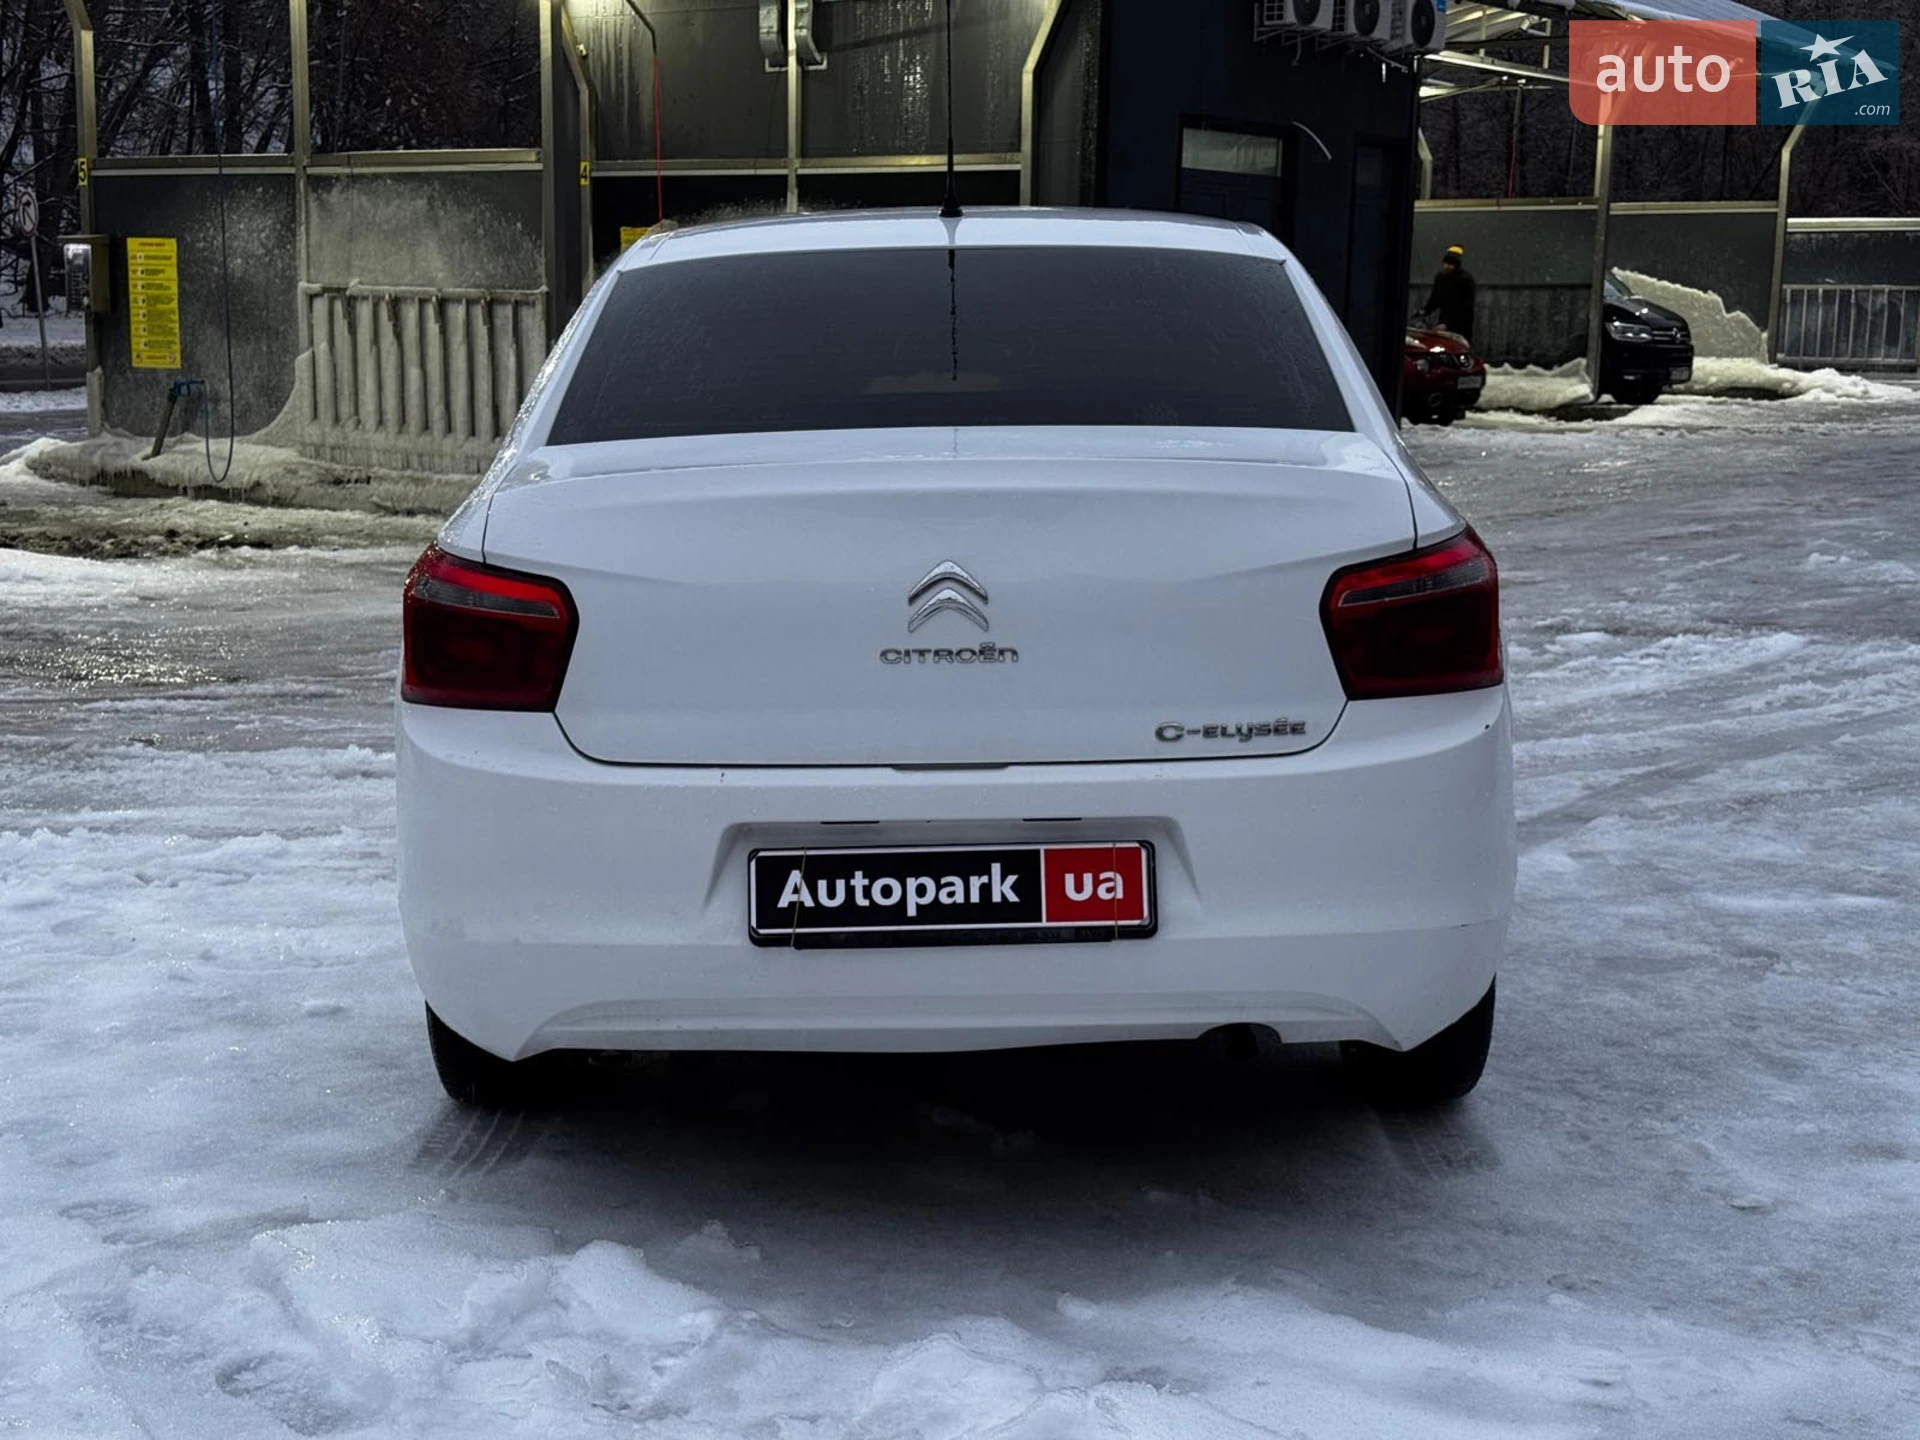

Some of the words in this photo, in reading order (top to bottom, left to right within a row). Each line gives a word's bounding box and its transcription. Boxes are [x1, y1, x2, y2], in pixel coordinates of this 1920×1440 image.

[79, 160, 87, 182] 5
[580, 164, 589, 183] 4
[777, 863, 1020, 917] Autopark
[1063, 870, 1124, 901] ua
